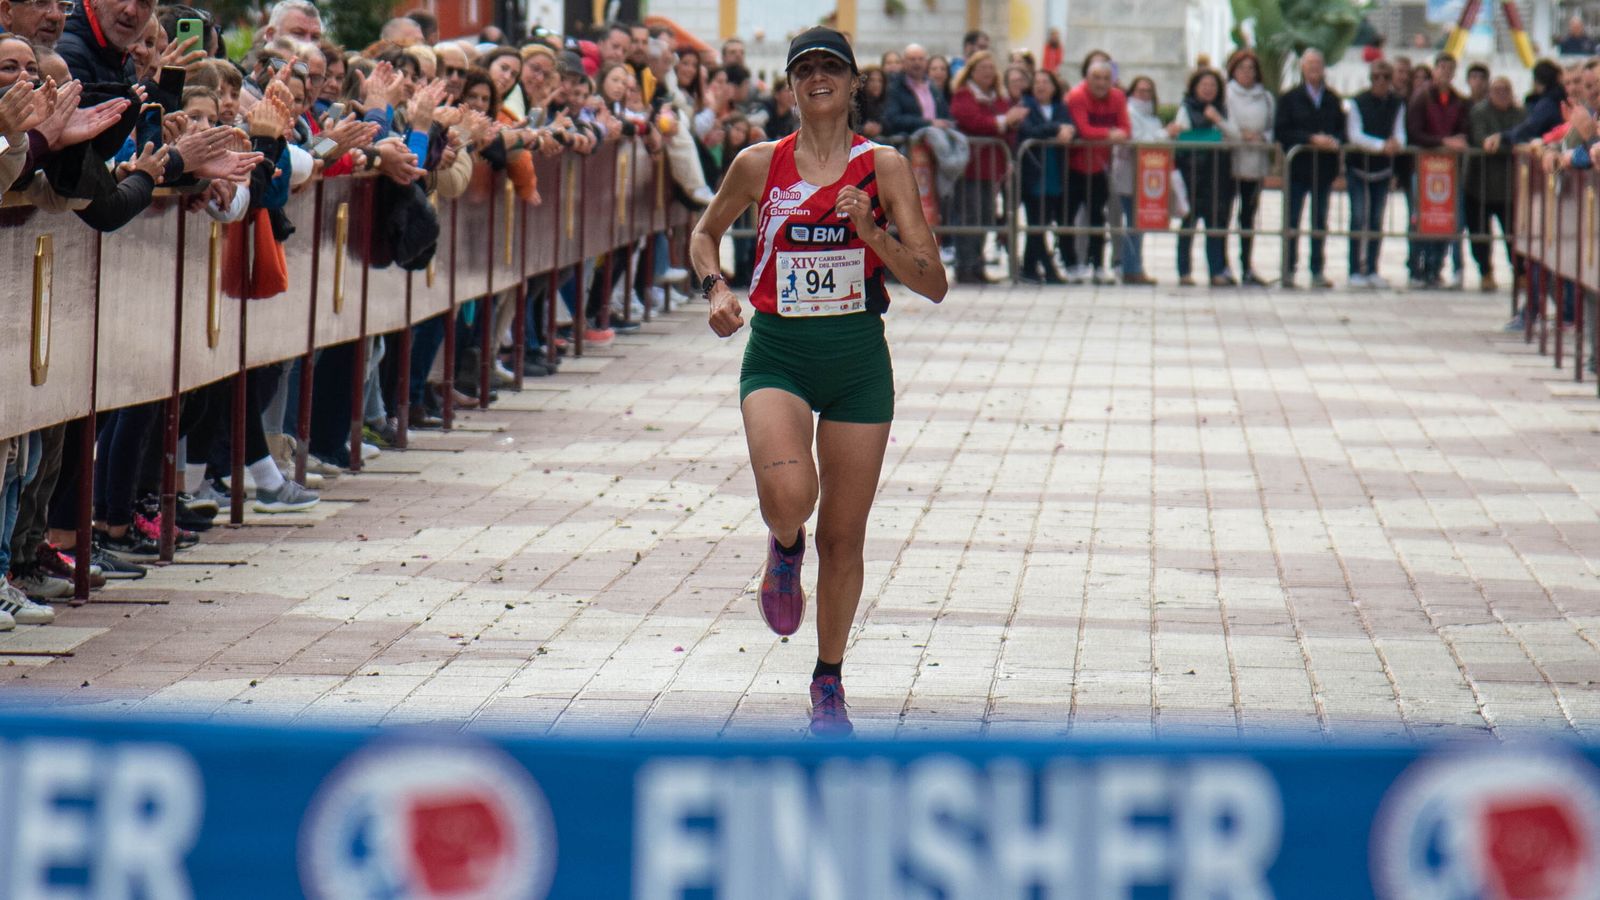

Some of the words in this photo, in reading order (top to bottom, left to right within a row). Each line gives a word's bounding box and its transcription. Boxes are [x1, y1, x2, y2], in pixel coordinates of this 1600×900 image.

[770, 187, 801, 202] Bilbao
[770, 208, 810, 216] Guedan
[812, 227, 845, 242] BM
[791, 257, 818, 269] XIV
[832, 260, 861, 268] ESTRECHO
[806, 269, 836, 294] 94
[632, 754, 1286, 900] FINISHER
